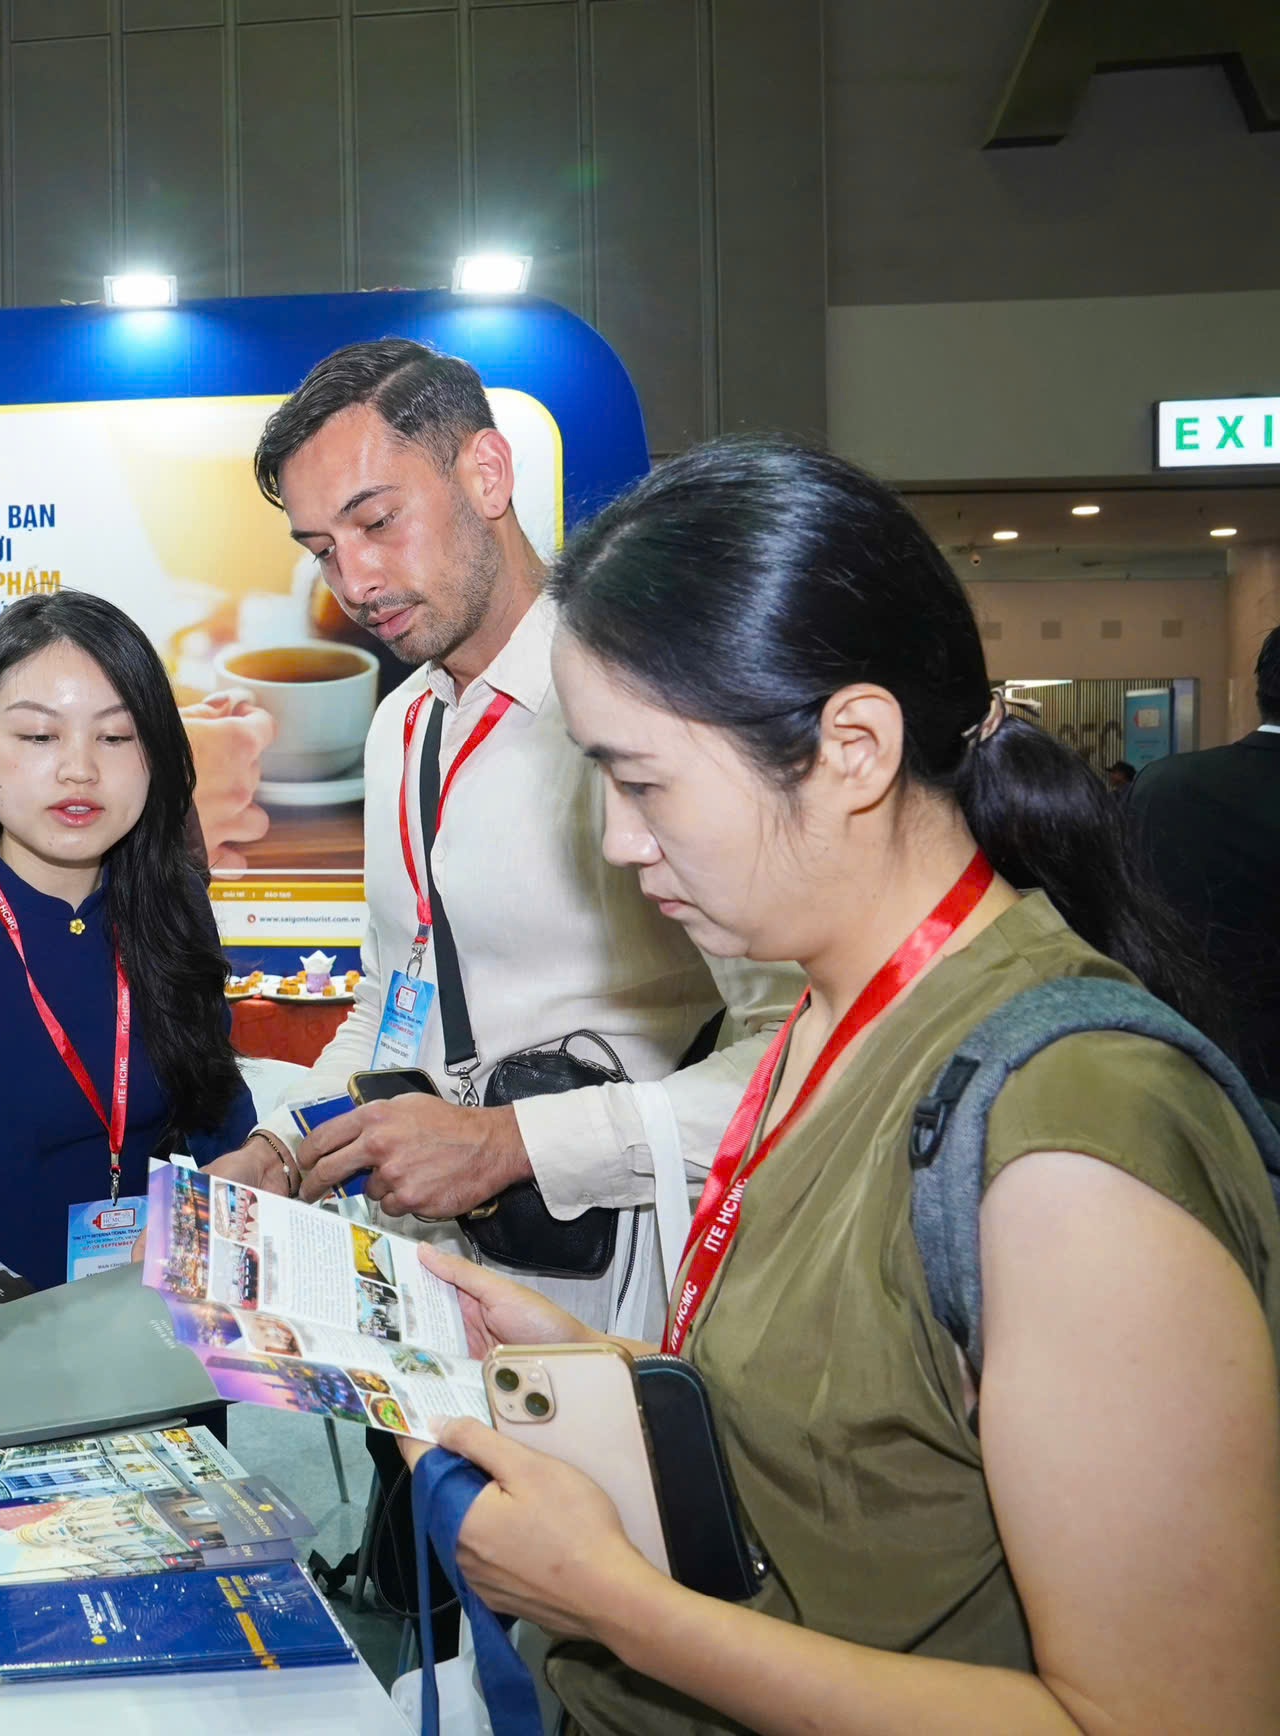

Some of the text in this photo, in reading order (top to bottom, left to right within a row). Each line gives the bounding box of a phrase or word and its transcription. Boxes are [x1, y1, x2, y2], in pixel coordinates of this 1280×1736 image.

[1175, 414, 1274, 451] EXI
[8, 504, 56, 532] BẠN
[0, 905, 18, 931] HCMC
[259, 915, 361, 925] www.saigontourist.com.vn
[117, 1056, 128, 1104] ITE HCMC
[703, 1178, 748, 1253] ITE HCMC
[670, 1281, 698, 1350] ITE HCMC
